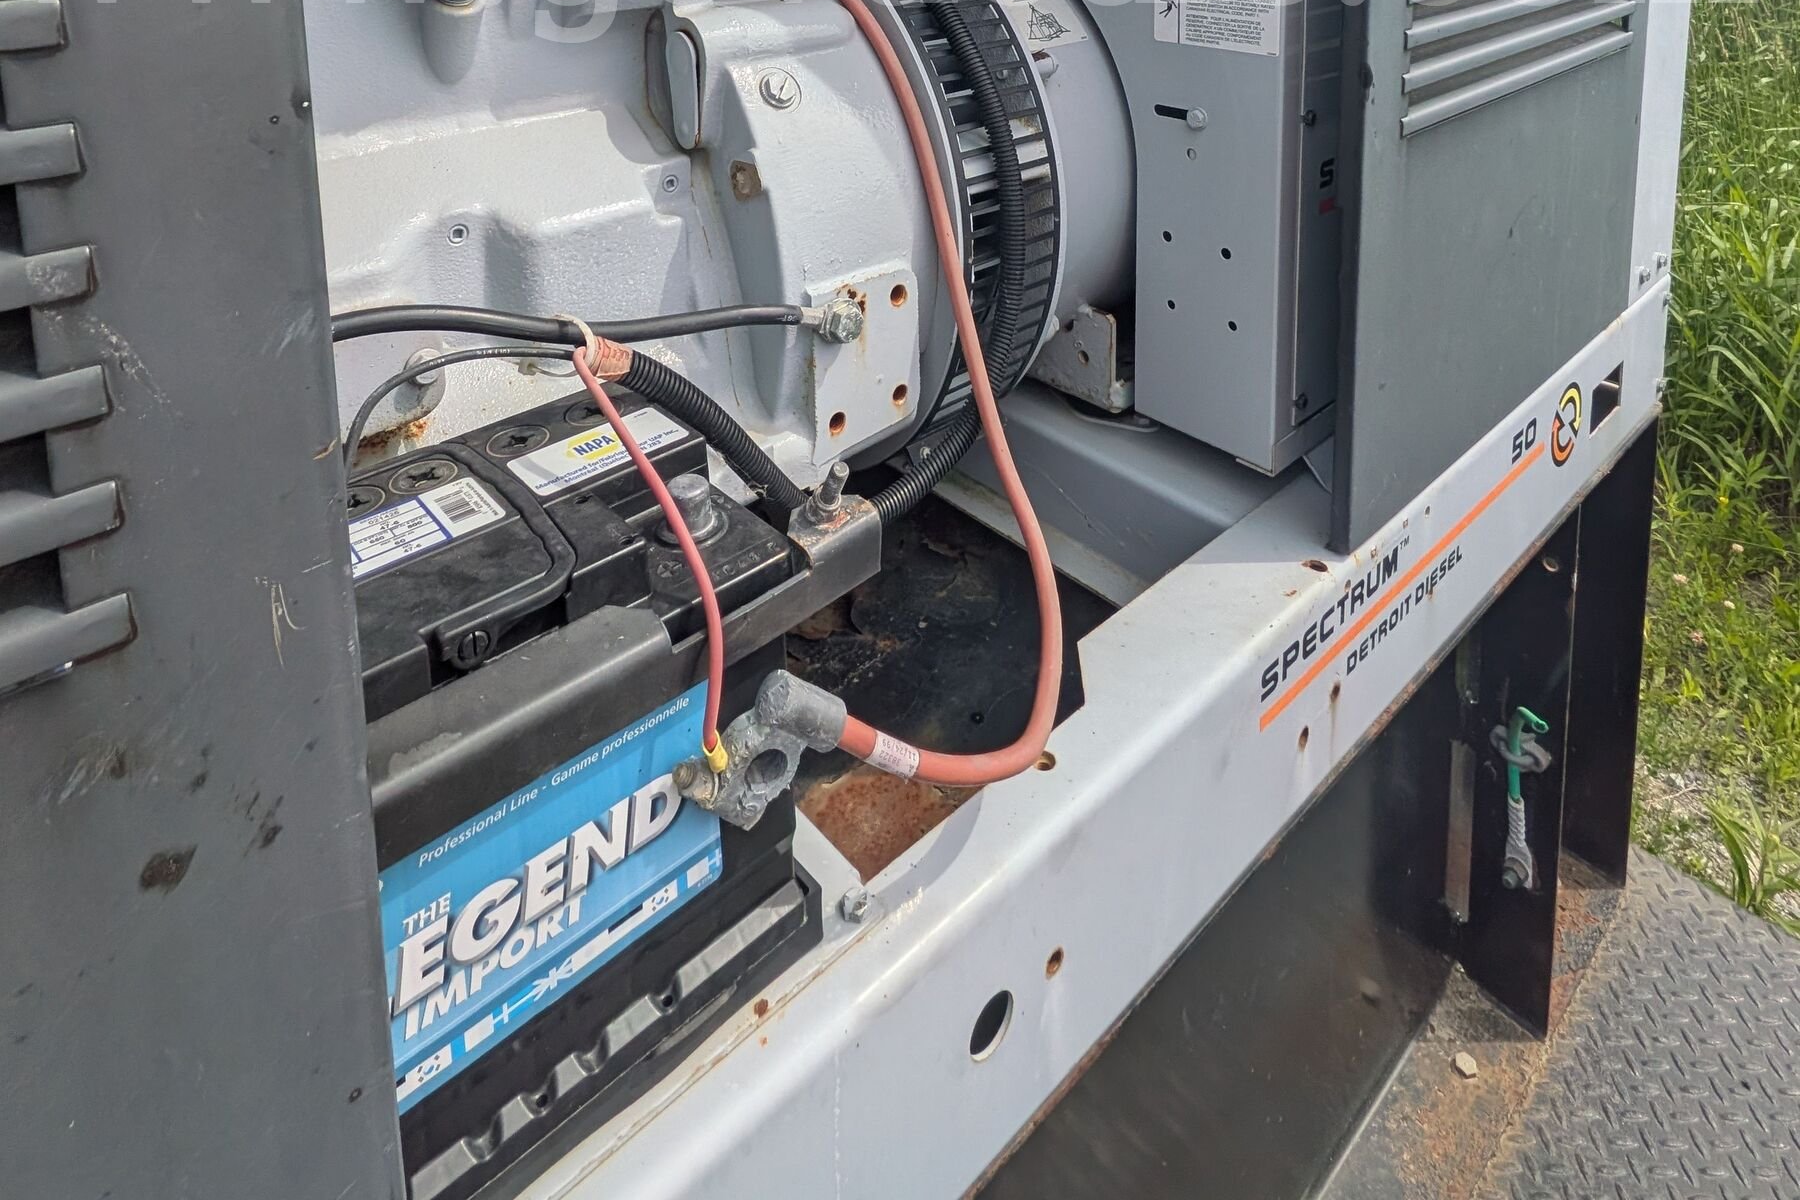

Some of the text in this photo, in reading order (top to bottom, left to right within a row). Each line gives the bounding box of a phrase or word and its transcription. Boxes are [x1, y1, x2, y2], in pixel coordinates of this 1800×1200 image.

[536, 464, 587, 490] Manufactured
[572, 435, 615, 456] NAPA
[1511, 416, 1538, 464] 50
[1346, 544, 1463, 676] DETROIT DIESEL
[418, 808, 506, 868] Professional
[510, 788, 538, 812] Line
[551, 753, 599, 786] Gamme
[602, 697, 689, 760] professionnelle
[390, 773, 682, 1020] EGEND
[403, 892, 451, 935] THE
[404, 891, 587, 1040] IMPORT
